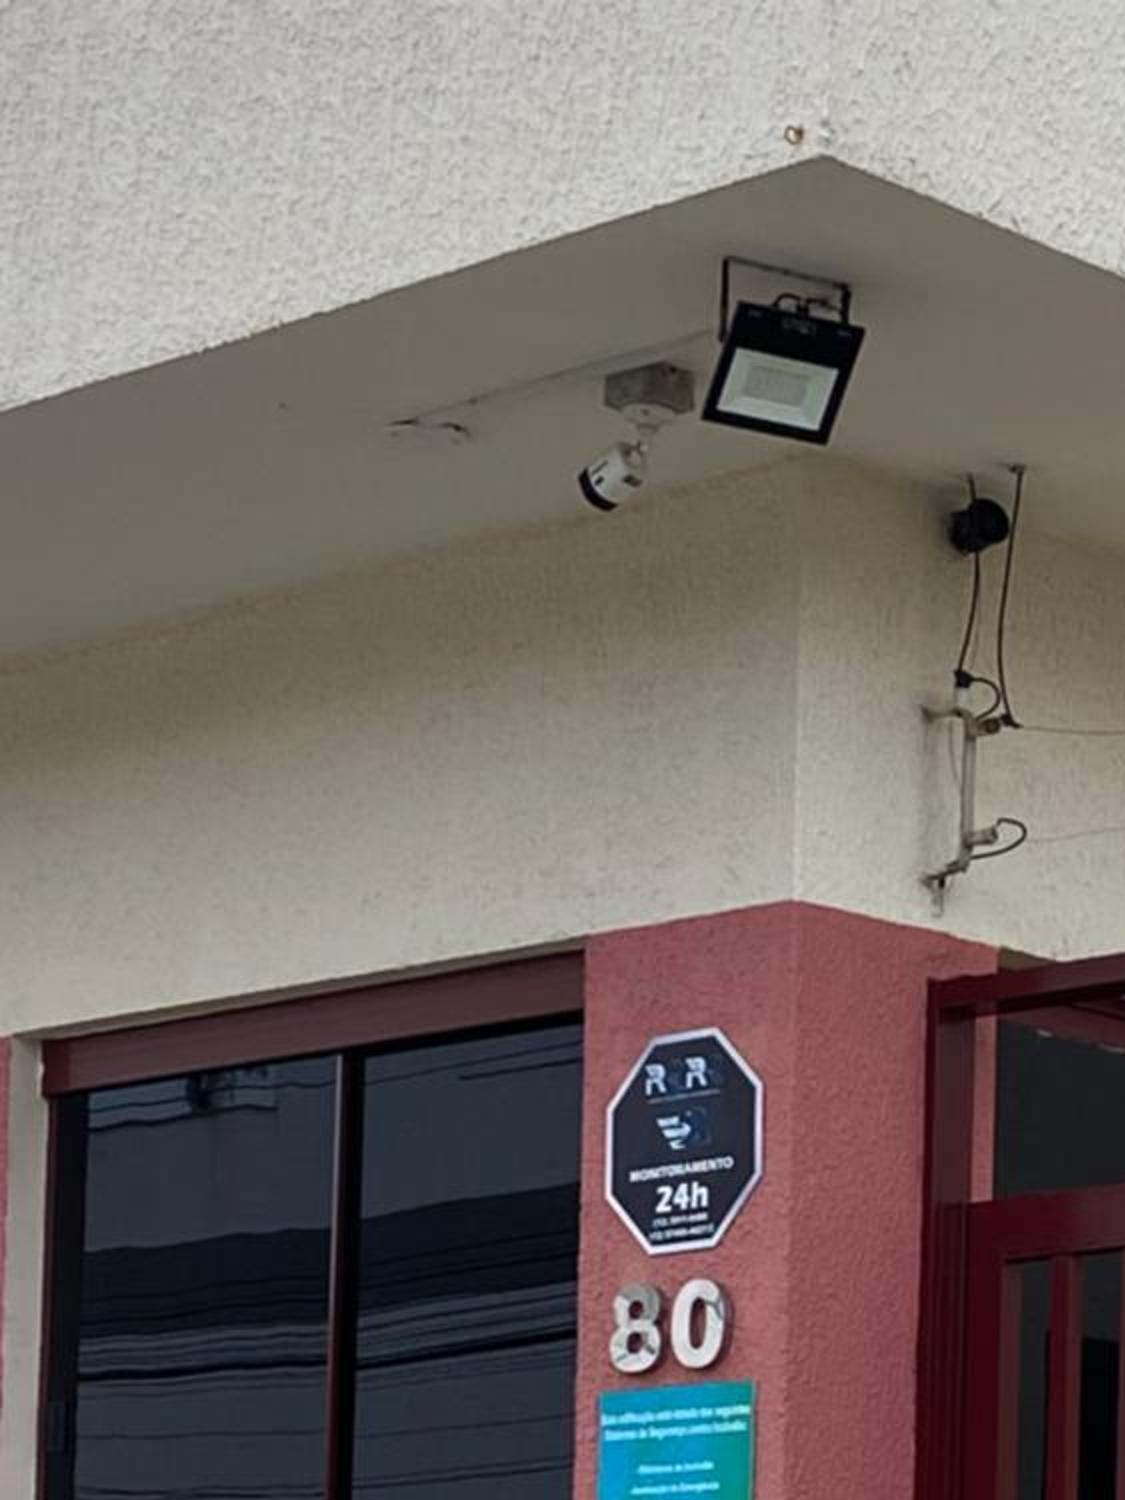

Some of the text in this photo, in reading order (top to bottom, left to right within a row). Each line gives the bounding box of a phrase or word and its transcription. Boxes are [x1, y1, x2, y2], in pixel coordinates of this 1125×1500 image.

[629, 1156, 734, 1182] MONITORAMENTO
[656, 1181, 708, 1213] 24h
[609, 1278, 732, 1374] 80
